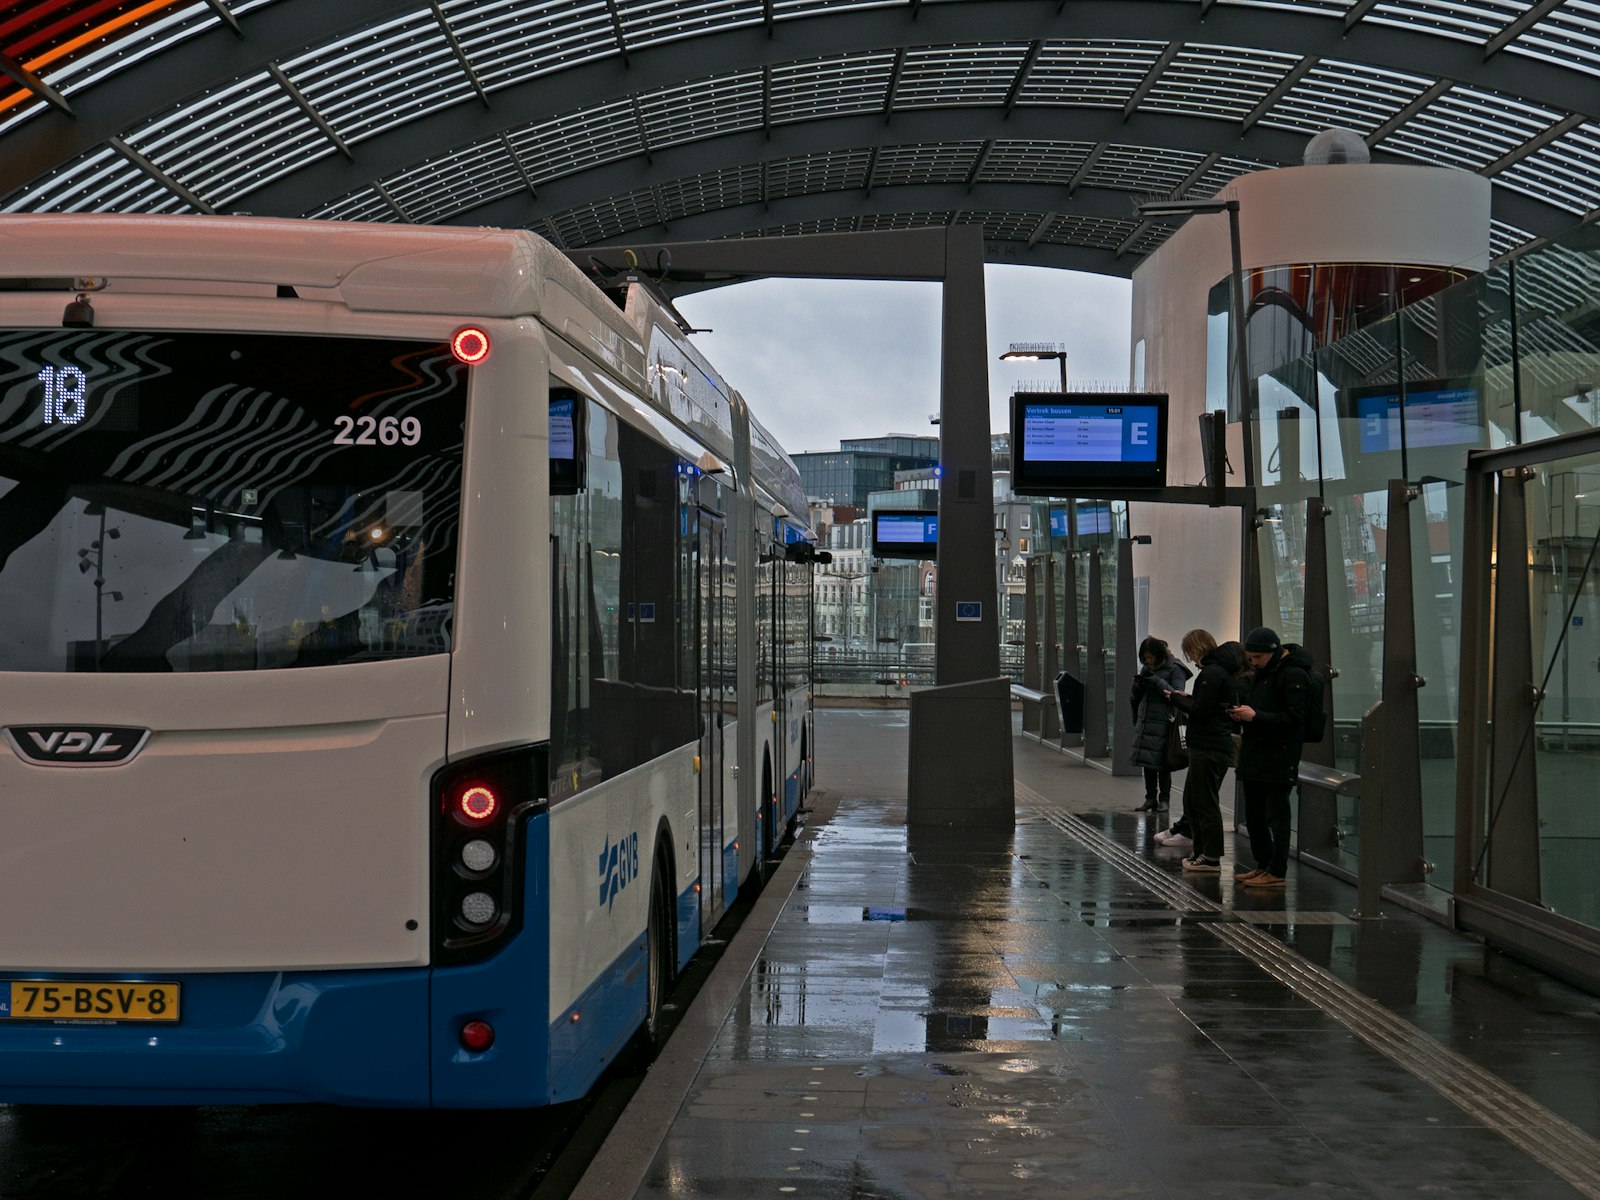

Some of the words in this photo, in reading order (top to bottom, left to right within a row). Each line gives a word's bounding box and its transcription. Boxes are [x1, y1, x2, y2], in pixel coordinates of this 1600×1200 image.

[38, 366, 86, 424] 18
[333, 415, 421, 446] 2269
[1131, 422, 1148, 445] E
[928, 523, 936, 534] F
[27, 731, 122, 754] VDL
[619, 831, 638, 890] GVB
[22, 986, 166, 1015] 75-BSV-8
